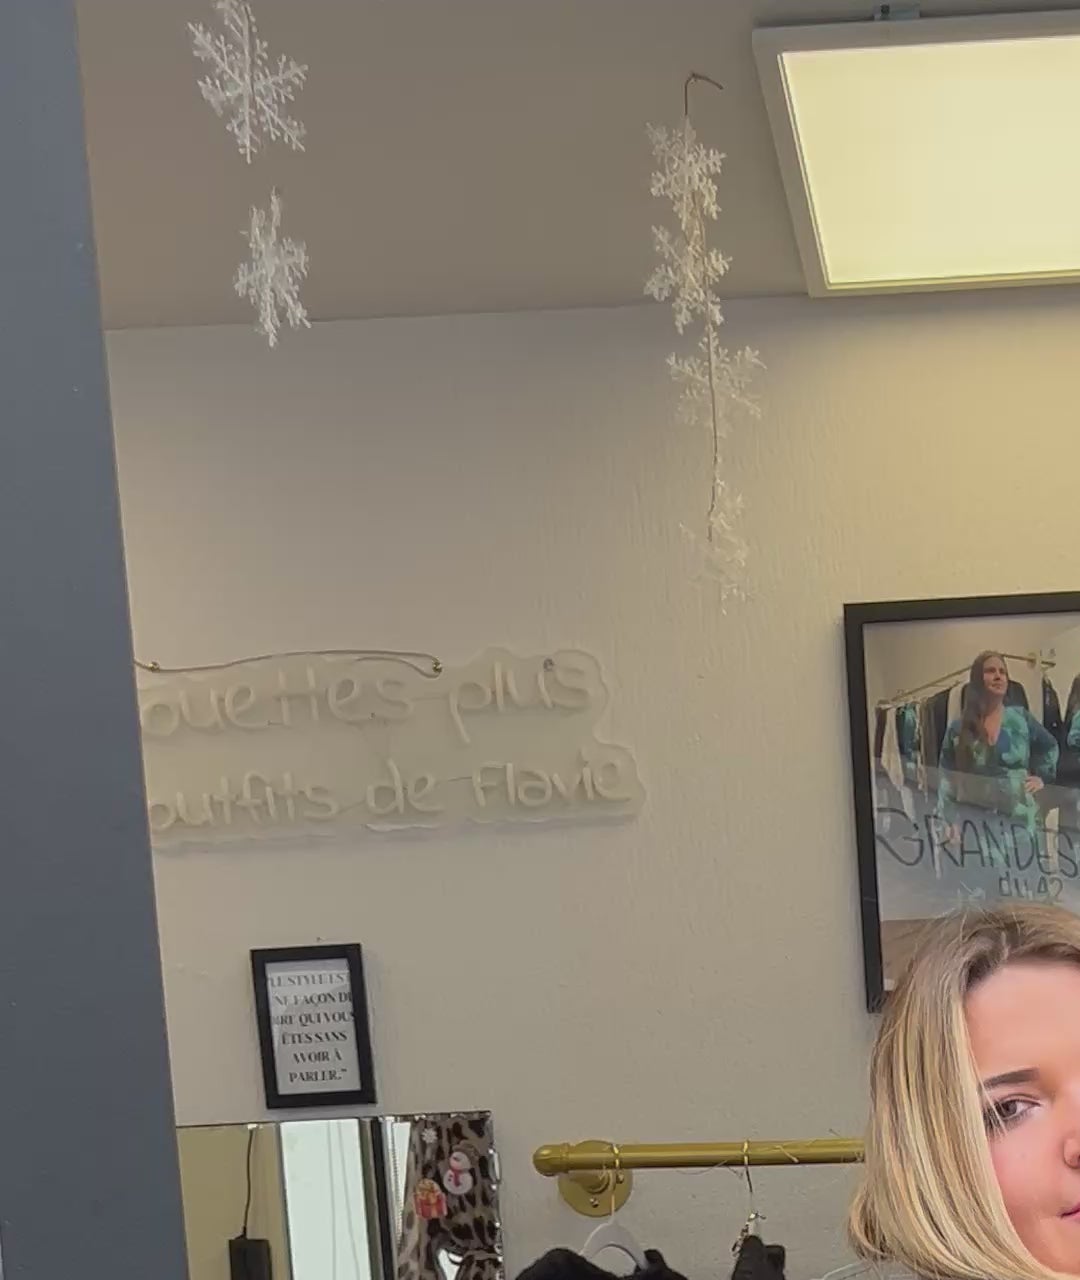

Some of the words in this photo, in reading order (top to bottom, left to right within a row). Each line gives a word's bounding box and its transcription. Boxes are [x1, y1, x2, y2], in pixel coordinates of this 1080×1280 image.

[449, 660, 592, 744] plus
[148, 769, 342, 831] outfits
[366, 757, 446, 814] de
[470, 751, 633, 808] Flavie
[875, 806, 1079, 879] GRANDES
[287, 974, 326, 986] STYLE
[328, 973, 350, 984] ES
[292, 991, 337, 1007] FAÇON
[298, 1012, 321, 1027] QUI
[314, 1030, 348, 1043] SANS
[293, 1051, 330, 1064] AVOIR
